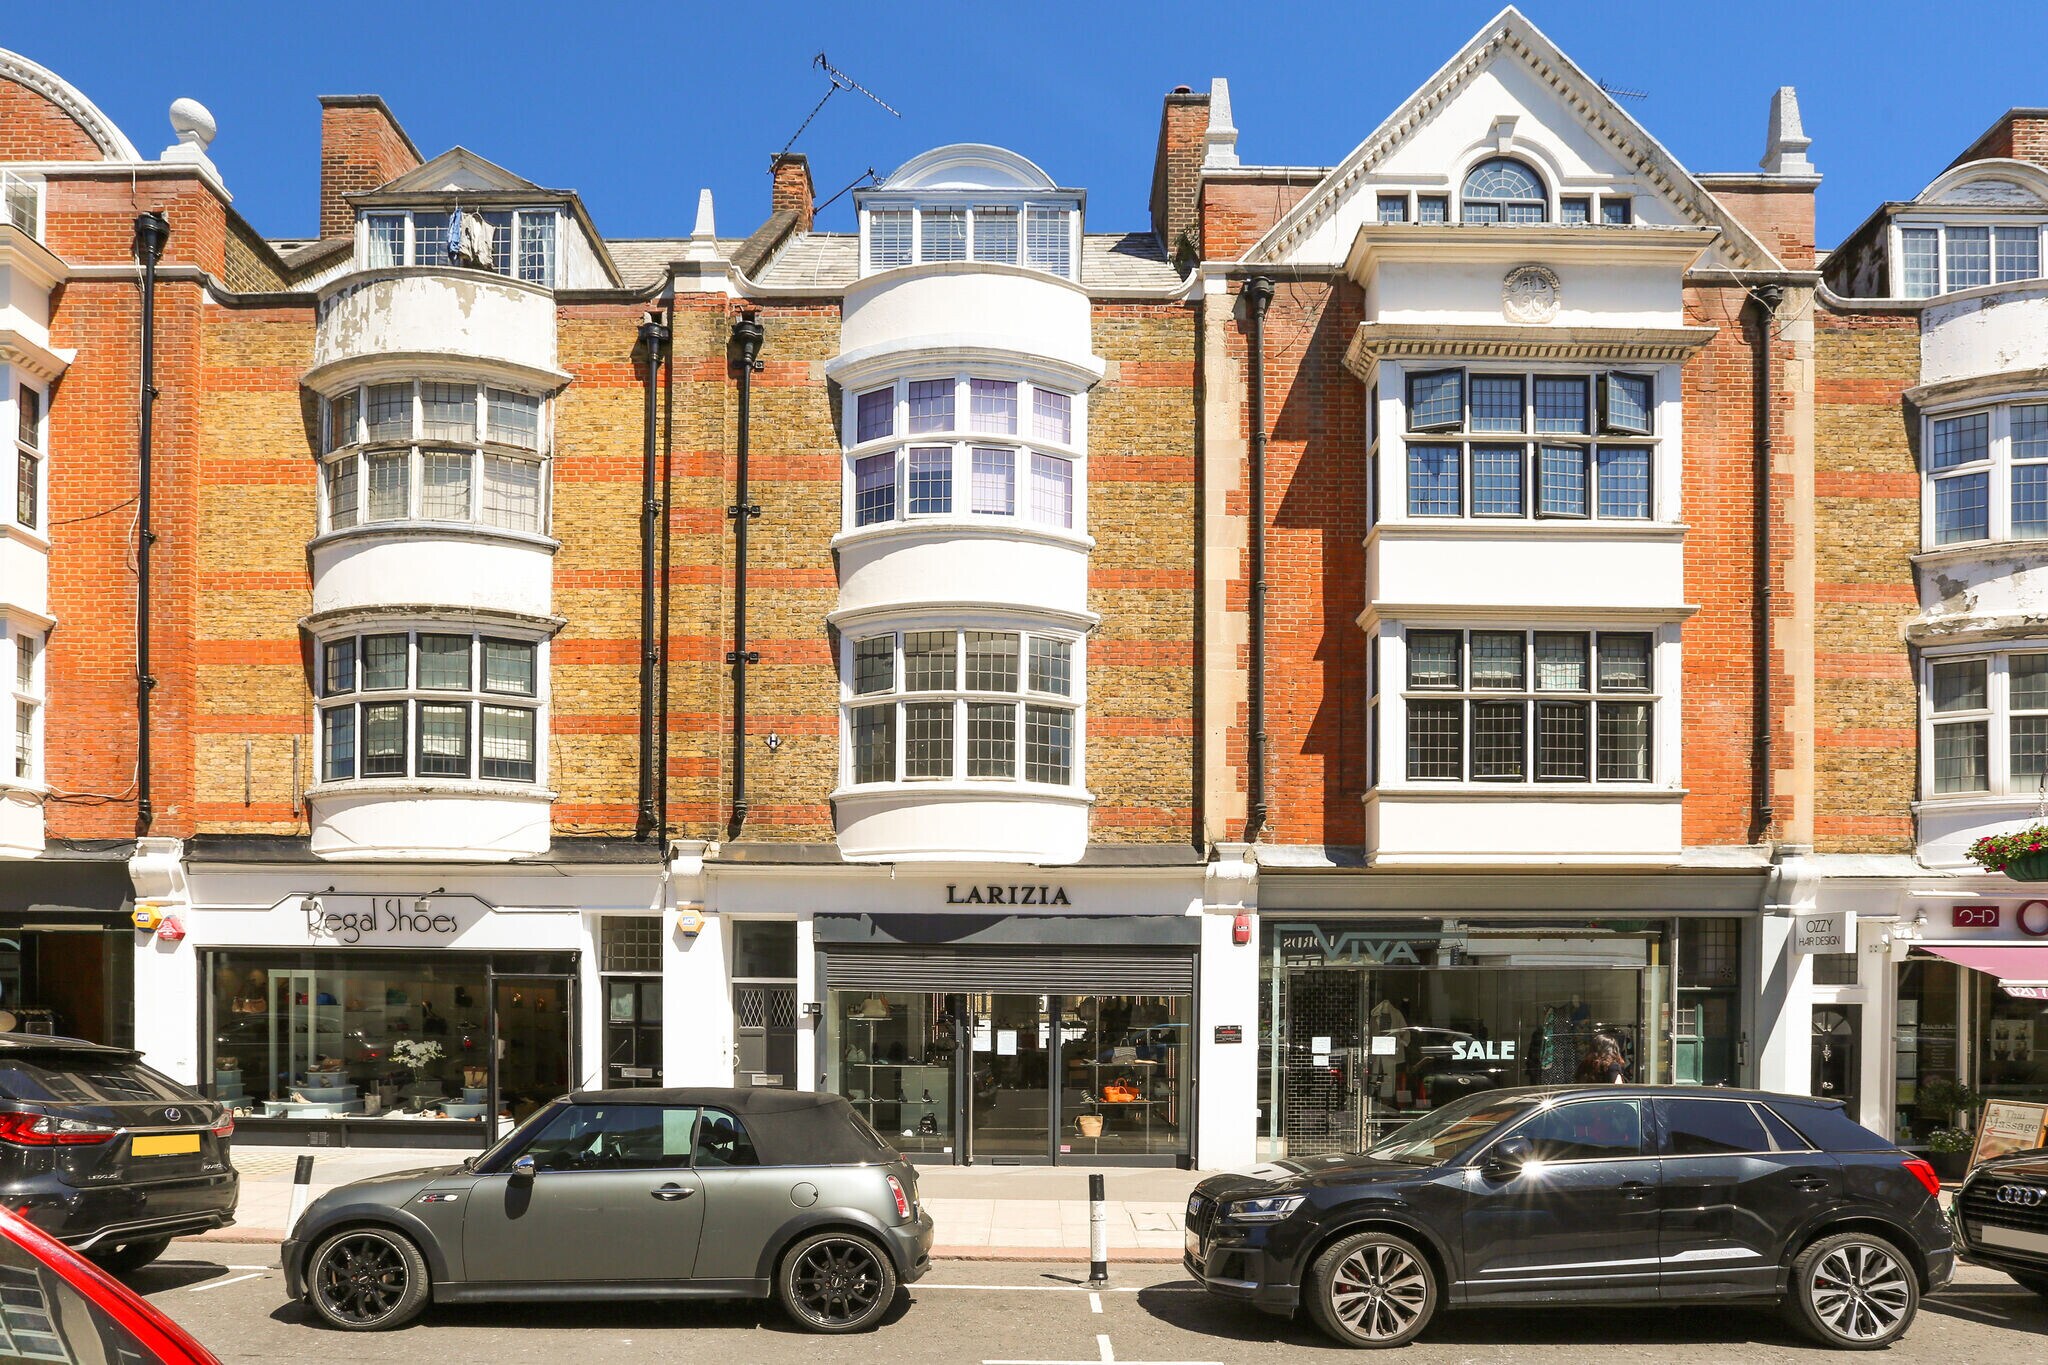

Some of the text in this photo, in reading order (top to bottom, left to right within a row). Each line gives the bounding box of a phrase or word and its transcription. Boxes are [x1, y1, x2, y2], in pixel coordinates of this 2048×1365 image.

[946, 885, 1071, 905] LARIZIA
[307, 898, 458, 943] Regal Shoes
[1806, 919, 1833, 933] OZZY
[1310, 924, 1420, 963] VIVA
[1799, 935, 1840, 946] HAIR DESIGN
[1451, 1040, 1516, 1060] SALE
[2006, 1109, 2026, 1120] Thai
[1986, 1118, 2038, 1133] Massage
